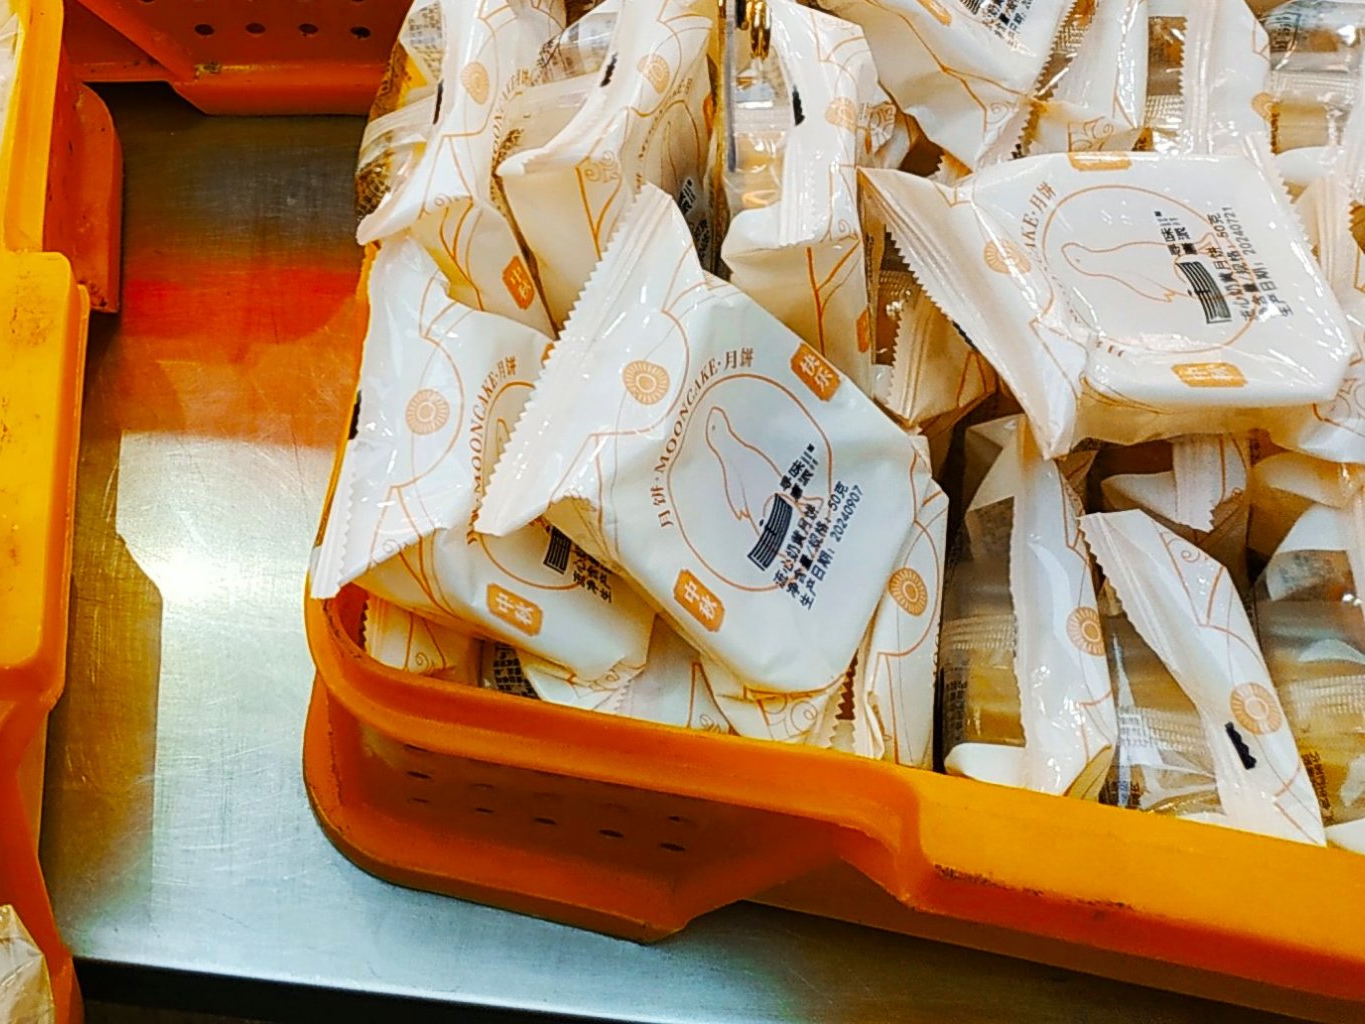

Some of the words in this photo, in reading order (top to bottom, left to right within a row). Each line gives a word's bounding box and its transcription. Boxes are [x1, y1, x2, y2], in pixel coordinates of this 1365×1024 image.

[800, 354, 834, 393] 快乐
[650, 347, 754, 529] 月饼·MOONCAKE·月饼
[772, 503, 818, 589] 流心奶黄月饼
[495, 592, 534, 627] 中秋
[683, 582, 719, 622] 中秋
